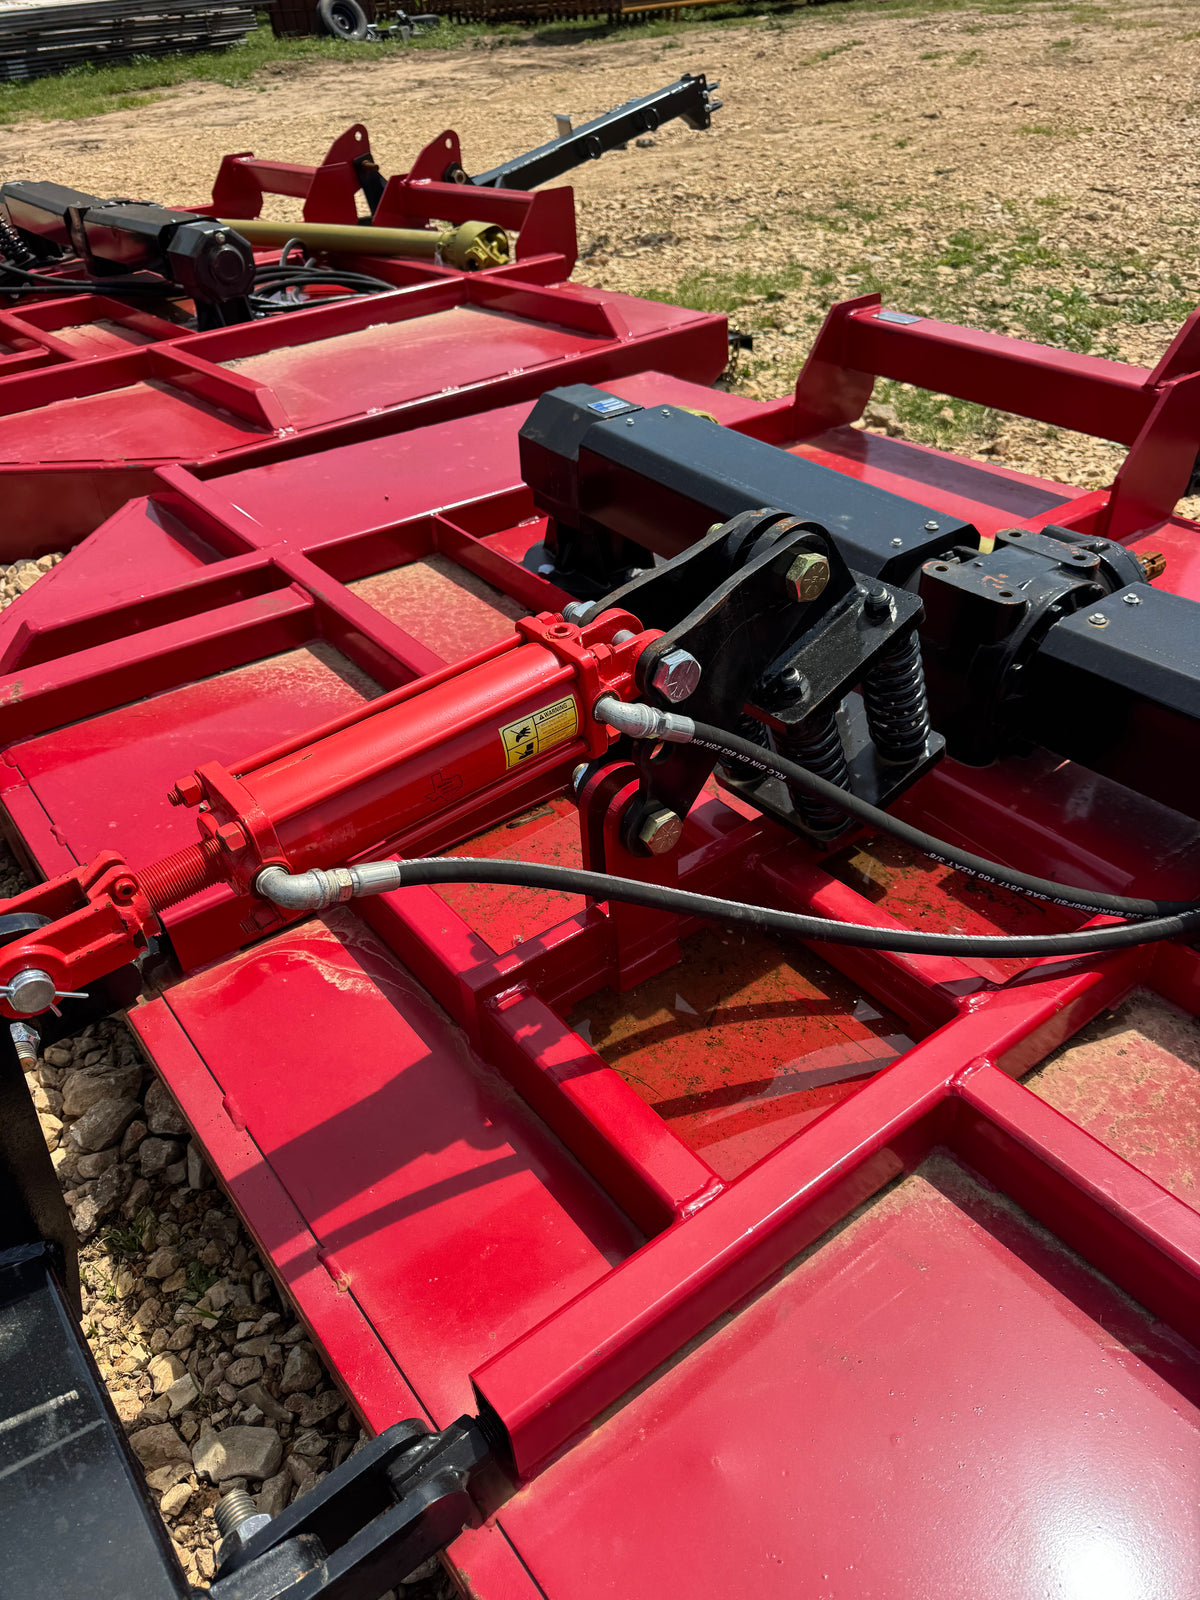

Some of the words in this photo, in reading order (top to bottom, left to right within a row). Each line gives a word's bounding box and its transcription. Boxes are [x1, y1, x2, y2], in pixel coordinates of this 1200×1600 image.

[543, 702, 568, 717] WARNING
[736, 754, 750, 763] EN
[751, 760, 767, 770] DIN
[767, 769, 787, 780] RLC
[946, 861, 976, 876] R2AT
[978, 873, 996, 883] 100
[999, 881, 1024, 892] J517
